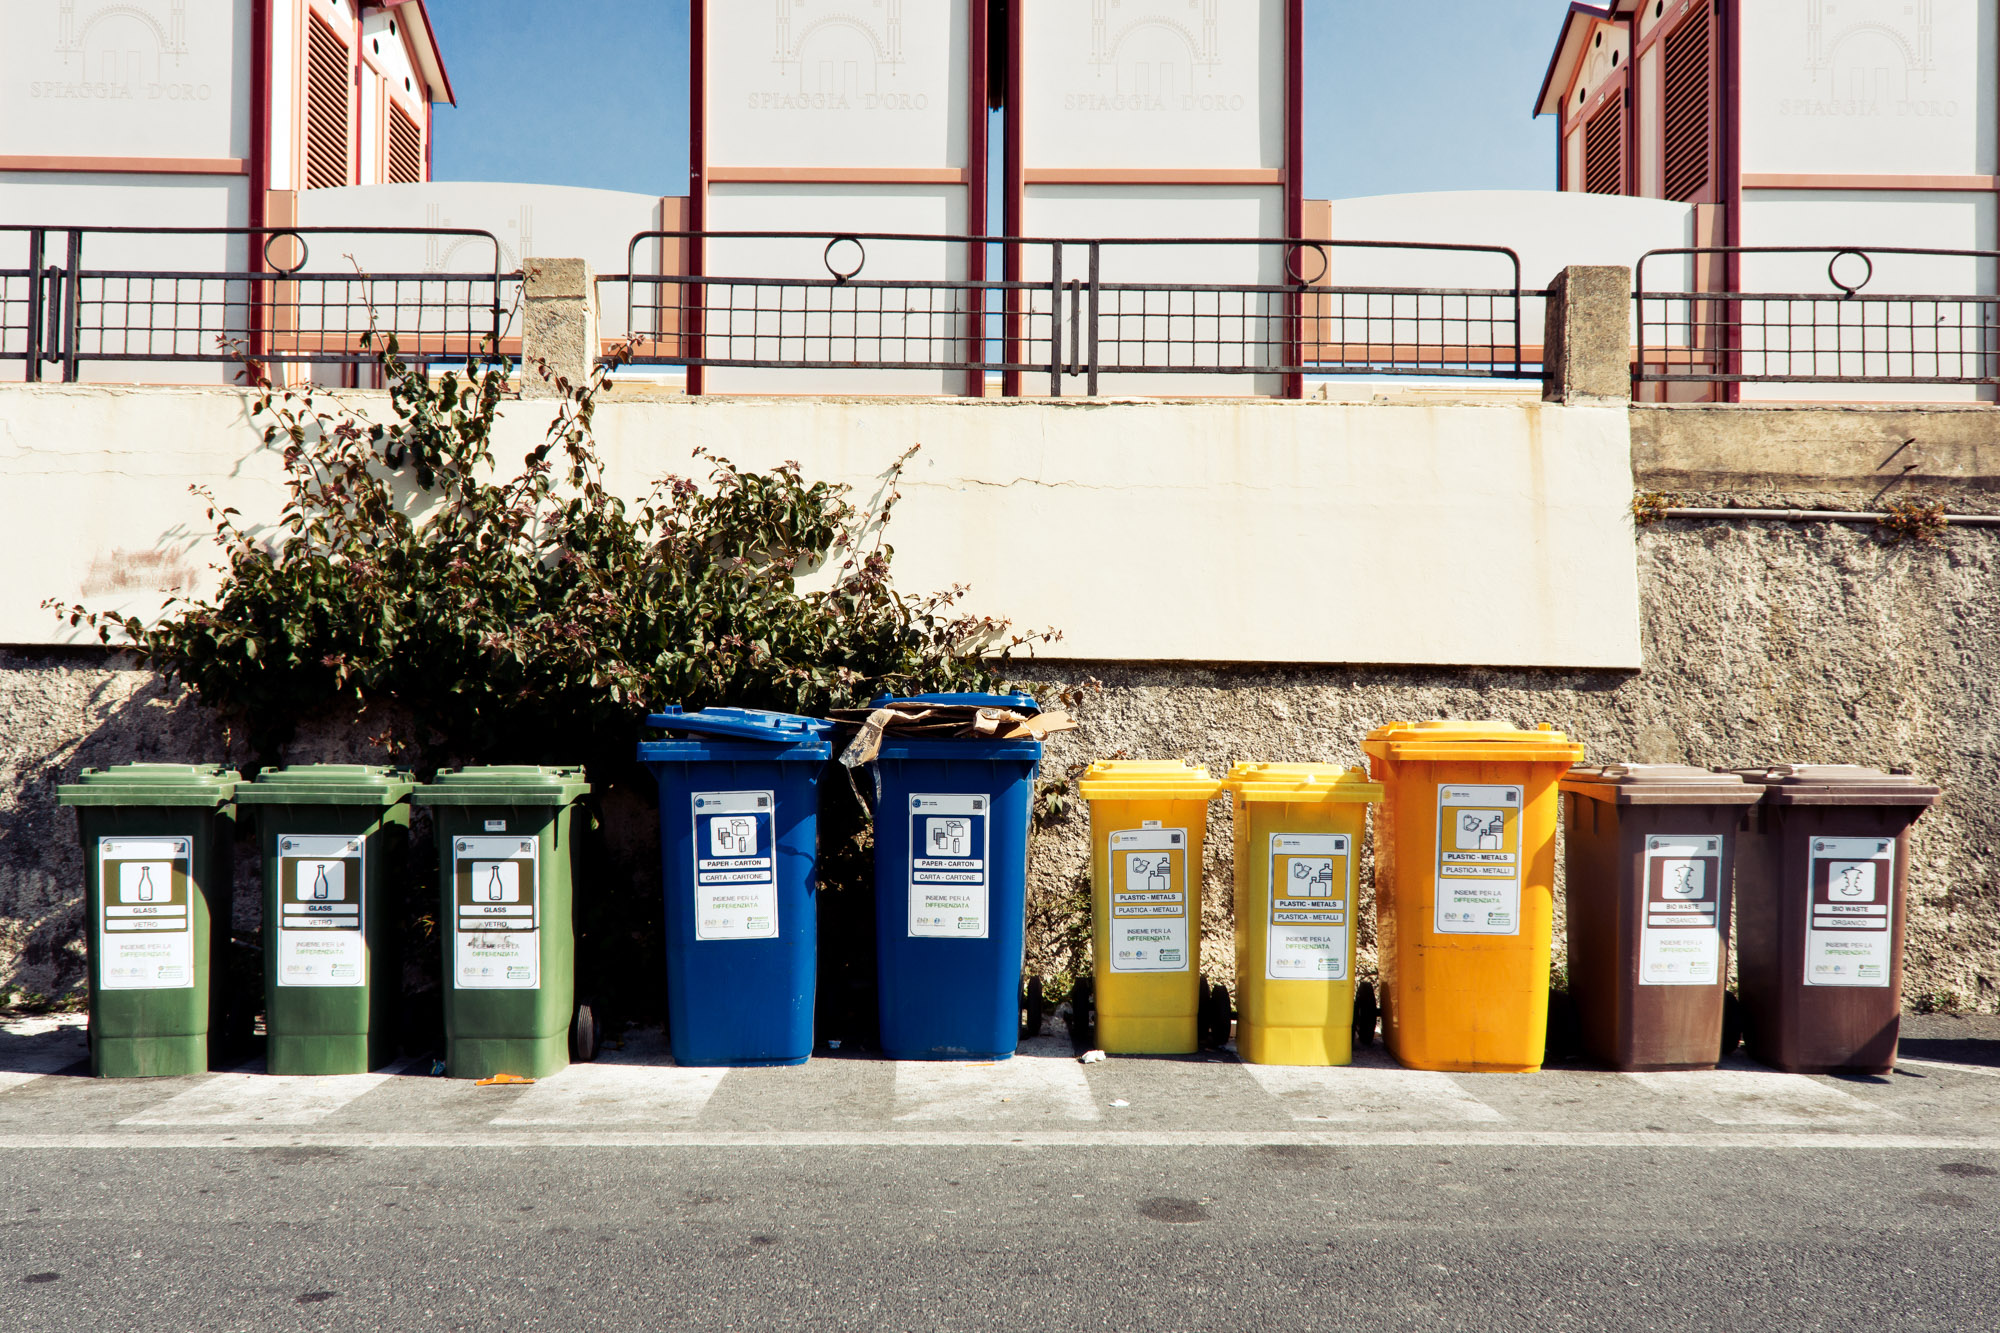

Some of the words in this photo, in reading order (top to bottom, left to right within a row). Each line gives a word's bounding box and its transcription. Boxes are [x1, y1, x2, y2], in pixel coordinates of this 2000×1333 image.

[30, 81, 133, 100] SPIAGGIA
[147, 82, 212, 101] D'ORO
[748, 92, 851, 111] SPIAGGIA
[865, 92, 929, 111] D'ORO
[1064, 93, 1166, 112] SPIAGGIA
[1181, 94, 1246, 112] D'ORO
[1779, 97, 1880, 116] SPIAGGIA
[1896, 99, 1958, 117] D'ORO
